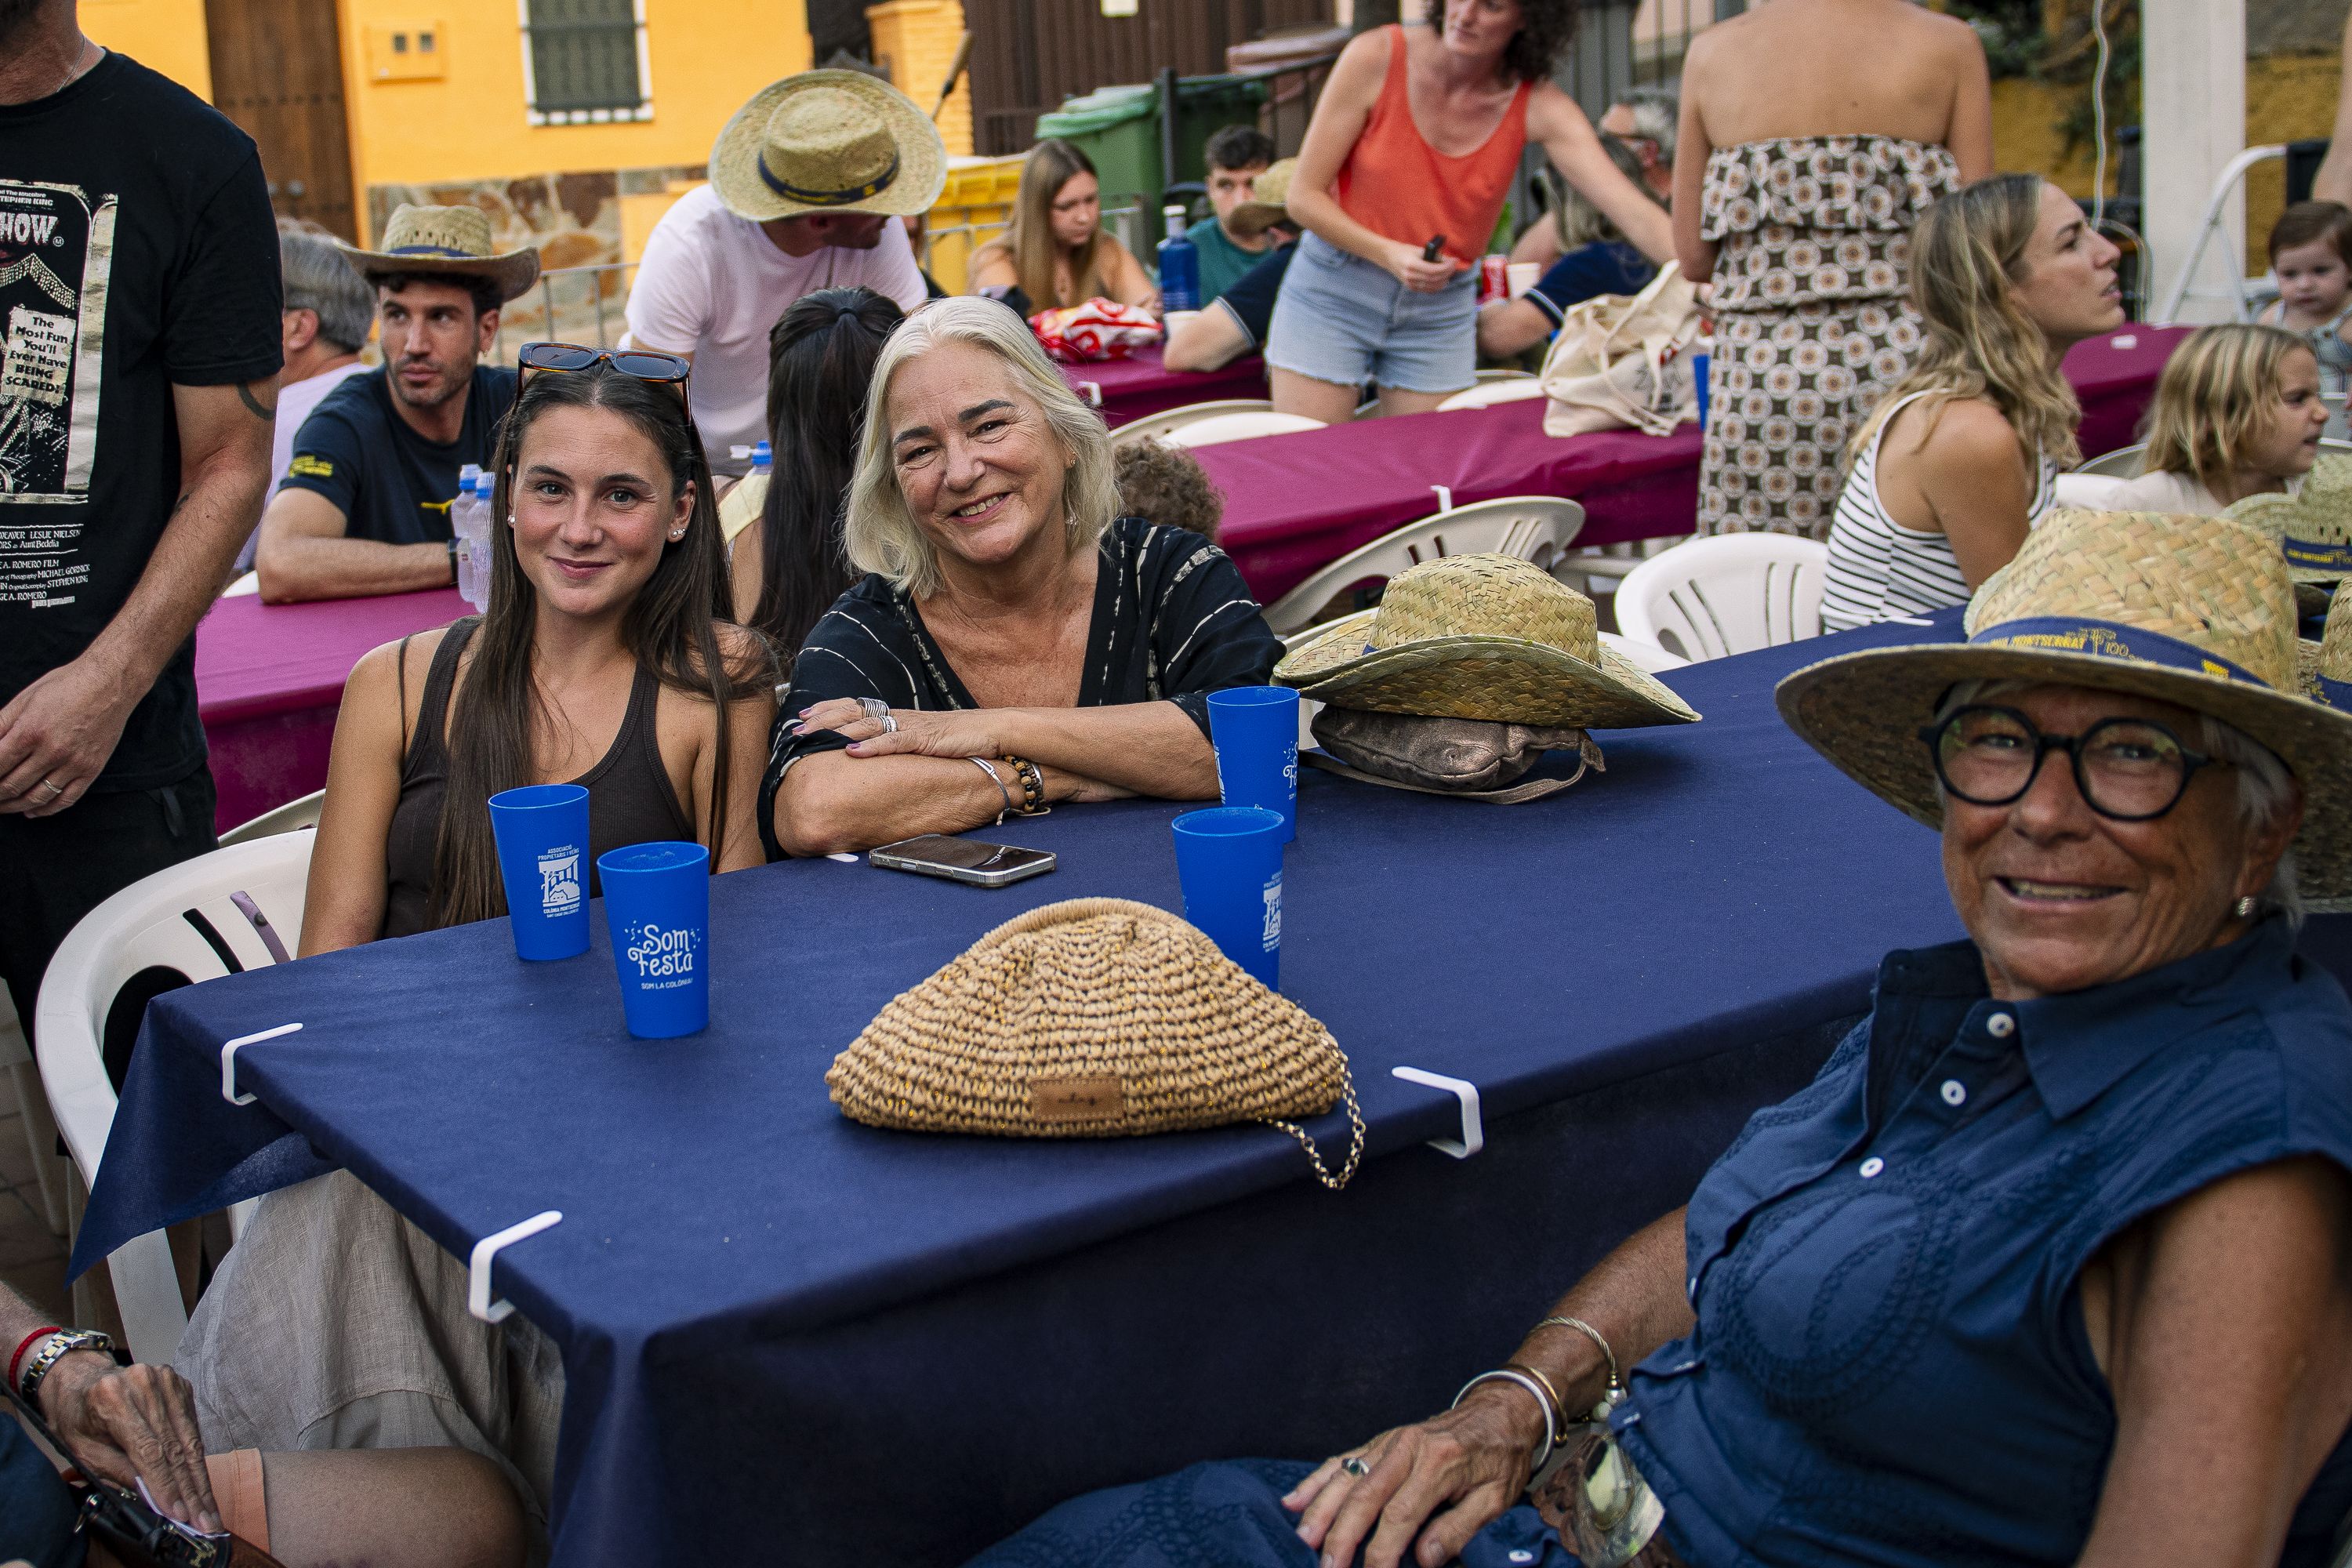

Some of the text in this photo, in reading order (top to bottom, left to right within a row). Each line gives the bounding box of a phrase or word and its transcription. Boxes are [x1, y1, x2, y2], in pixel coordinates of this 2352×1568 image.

[33, 198, 53, 206] KING
[33, 317, 54, 328] The
[16, 326, 67, 343] Most Fun
[24, 339, 56, 354] You'll
[9, 350, 67, 368] Ever Have
[16, 364, 53, 379] BEING
[5, 376, 60, 394] SCARED!
[30, 531, 52, 539] LESLIE
[53, 529, 81, 539] NIELSEN
[12, 560, 42, 569] ROMERO
[38, 568, 65, 579] MICHAEL
[66, 564, 90, 575] GORNICK
[47, 577, 75, 588] STEPHEN
[75, 575, 89, 584] KING
[17, 590, 47, 601] ROMERO
[643, 924, 690, 955] Som
[627, 947, 693, 977] Festa
